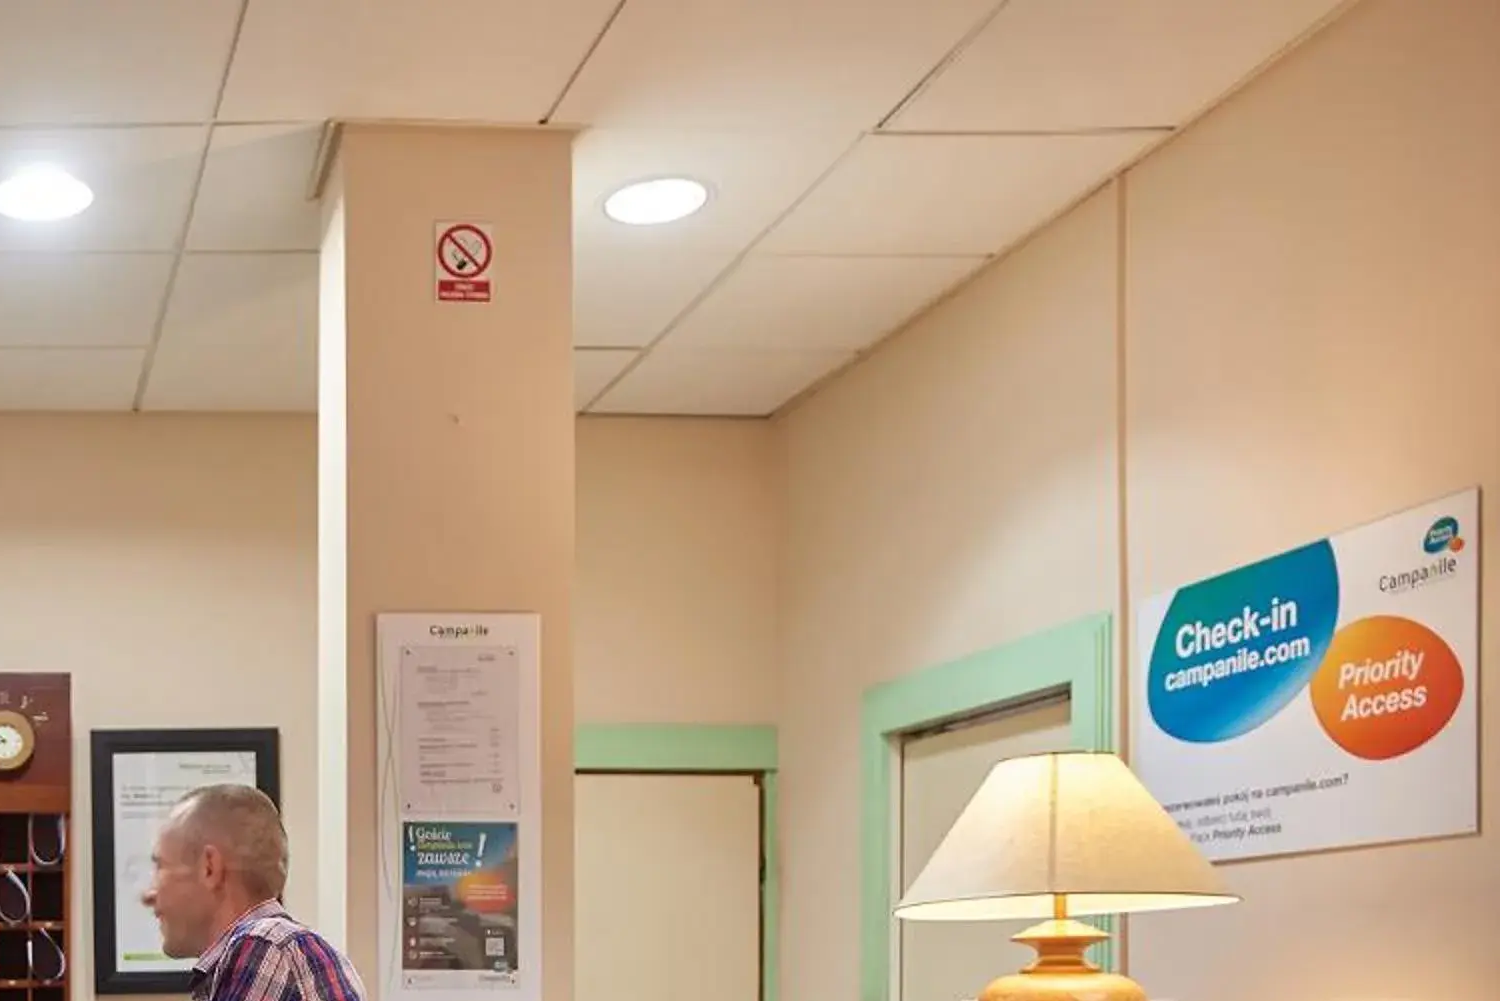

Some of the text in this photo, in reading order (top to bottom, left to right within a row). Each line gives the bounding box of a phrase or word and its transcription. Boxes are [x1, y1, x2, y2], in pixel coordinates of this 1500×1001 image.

[1379, 557, 1457, 592] Campanile
[1175, 597, 1298, 659] Check-in
[1164, 636, 1311, 692] campanile.com
[1338, 647, 1425, 690] Priority
[1341, 685, 1428, 721] Access
